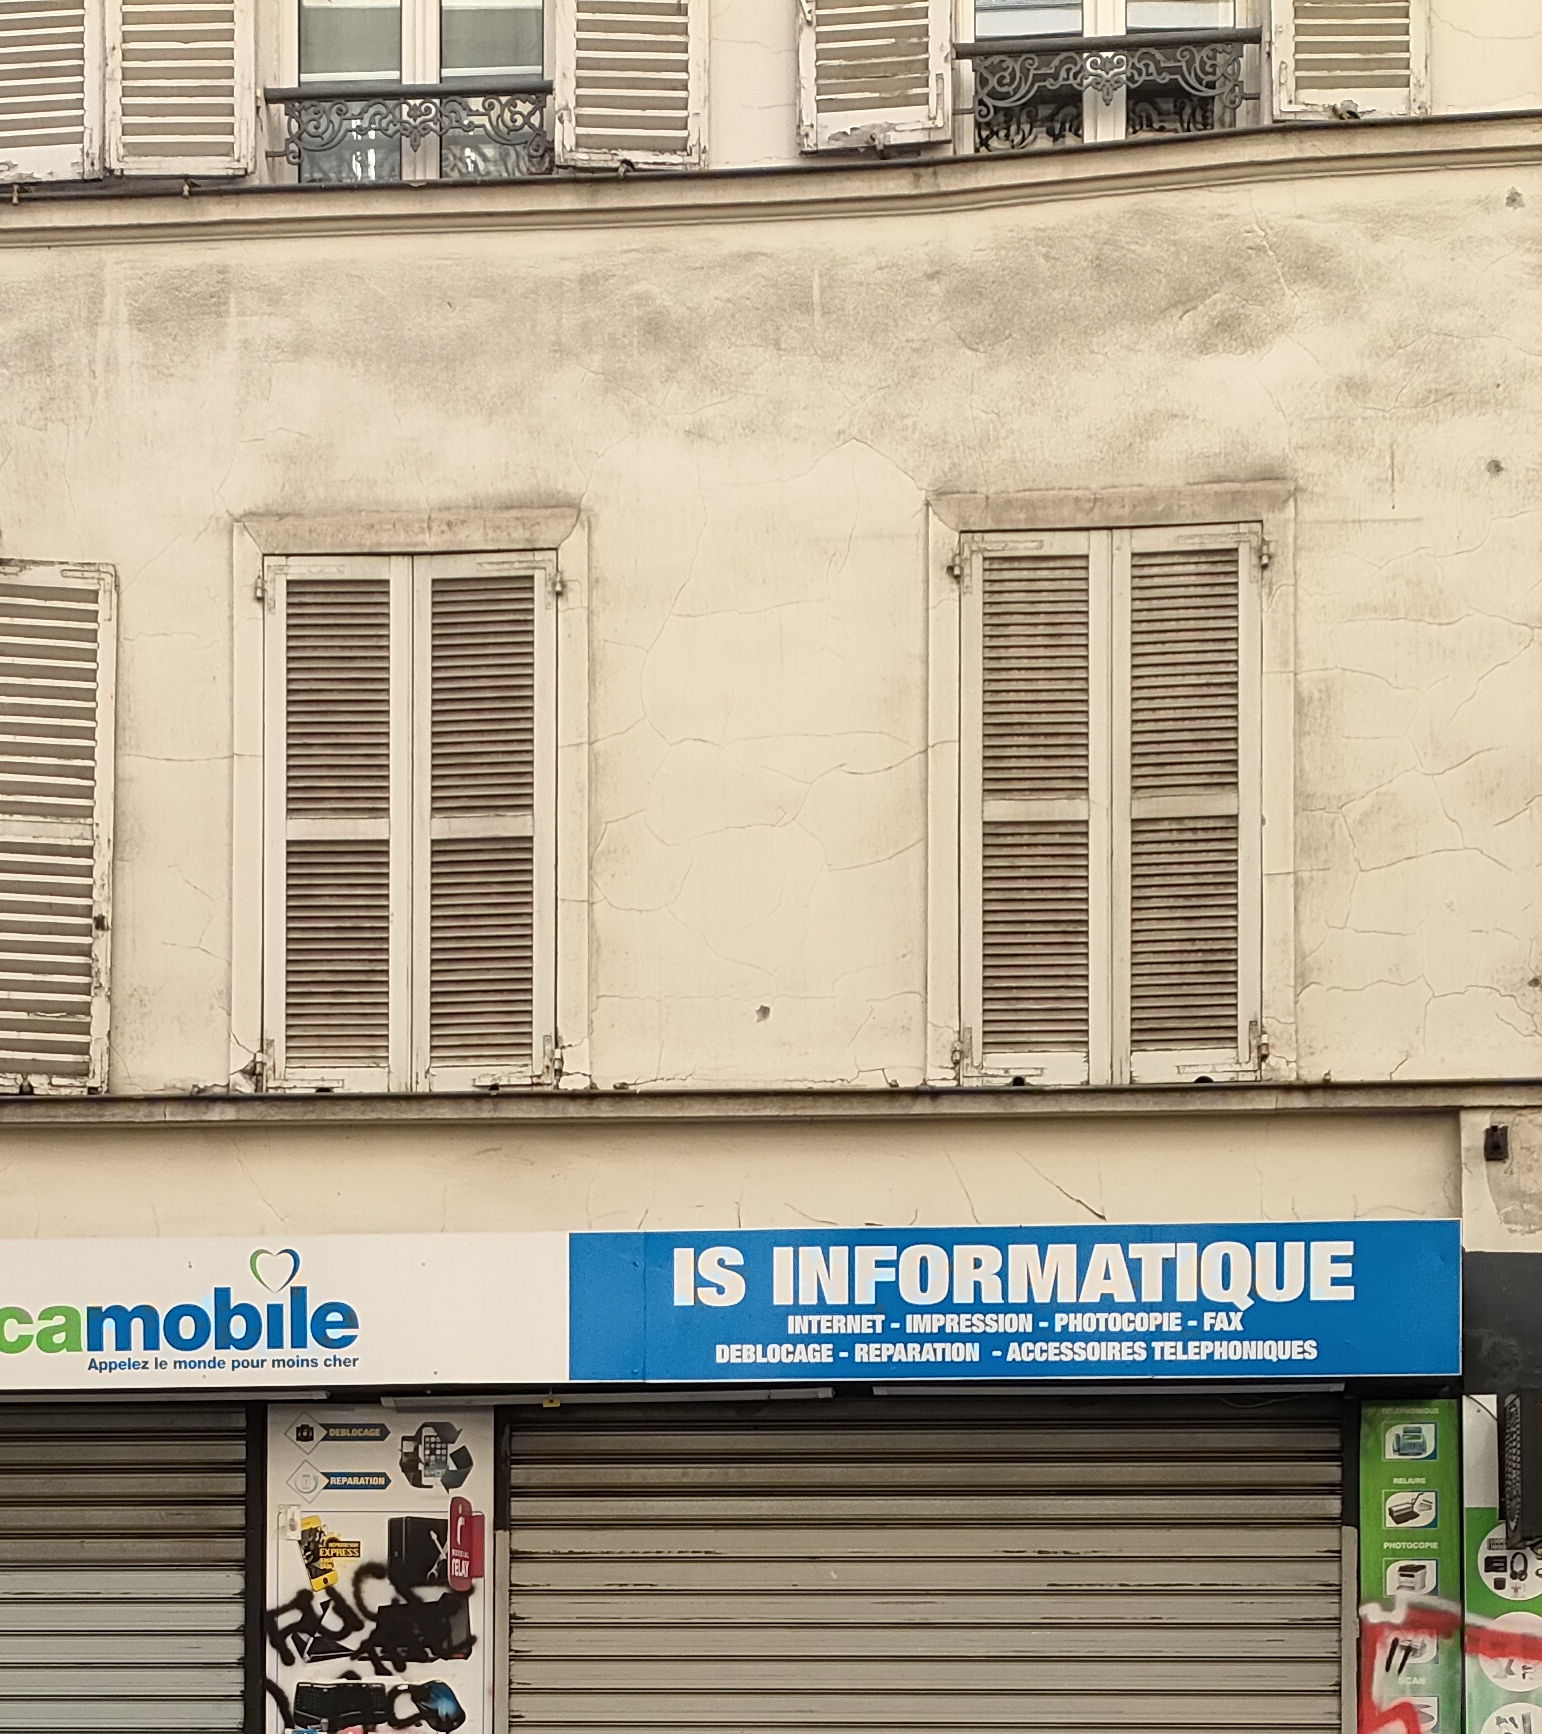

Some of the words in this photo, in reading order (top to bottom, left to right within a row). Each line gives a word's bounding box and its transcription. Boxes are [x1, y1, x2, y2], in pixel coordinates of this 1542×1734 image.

[673, 1246, 747, 1307] IS
[772, 1240, 1356, 1309] INFORMATIQUE
[787, 1315, 886, 1335] INTERNET
[905, 1313, 1033, 1333] IMPRESSION
[1054, 1312, 1182, 1332] PHOTOCOPIE
[1203, 1311, 1244, 1331] FAX
[715, 1343, 833, 1363] DEBLOCAGE
[854, 1342, 980, 1362] REPARATION
[1006, 1341, 1147, 1362] ACCESSOIRES
[1151, 1340, 1317, 1362] TELEPHONIQUES
[87, 1357, 149, 1373] Appelez
[154, 1356, 168, 1370] le
[173, 1356, 226, 1370] monde
[231, 1357, 267, 1372] pour
[271, 1355, 318, 1368] moins
[323, 1354, 359, 1367] cher
[329, 1427, 381, 1437] DEBLOCAGE
[330, 1476, 385, 1486] REPARATION
[1392, 1477, 1427, 1485] RELIURE
[1382, 1541, 1439, 1549] PHOTOCOPIE
[319, 1548, 359, 1556] EXPRESS
[1397, 1676, 1426, 1685] SCAN
